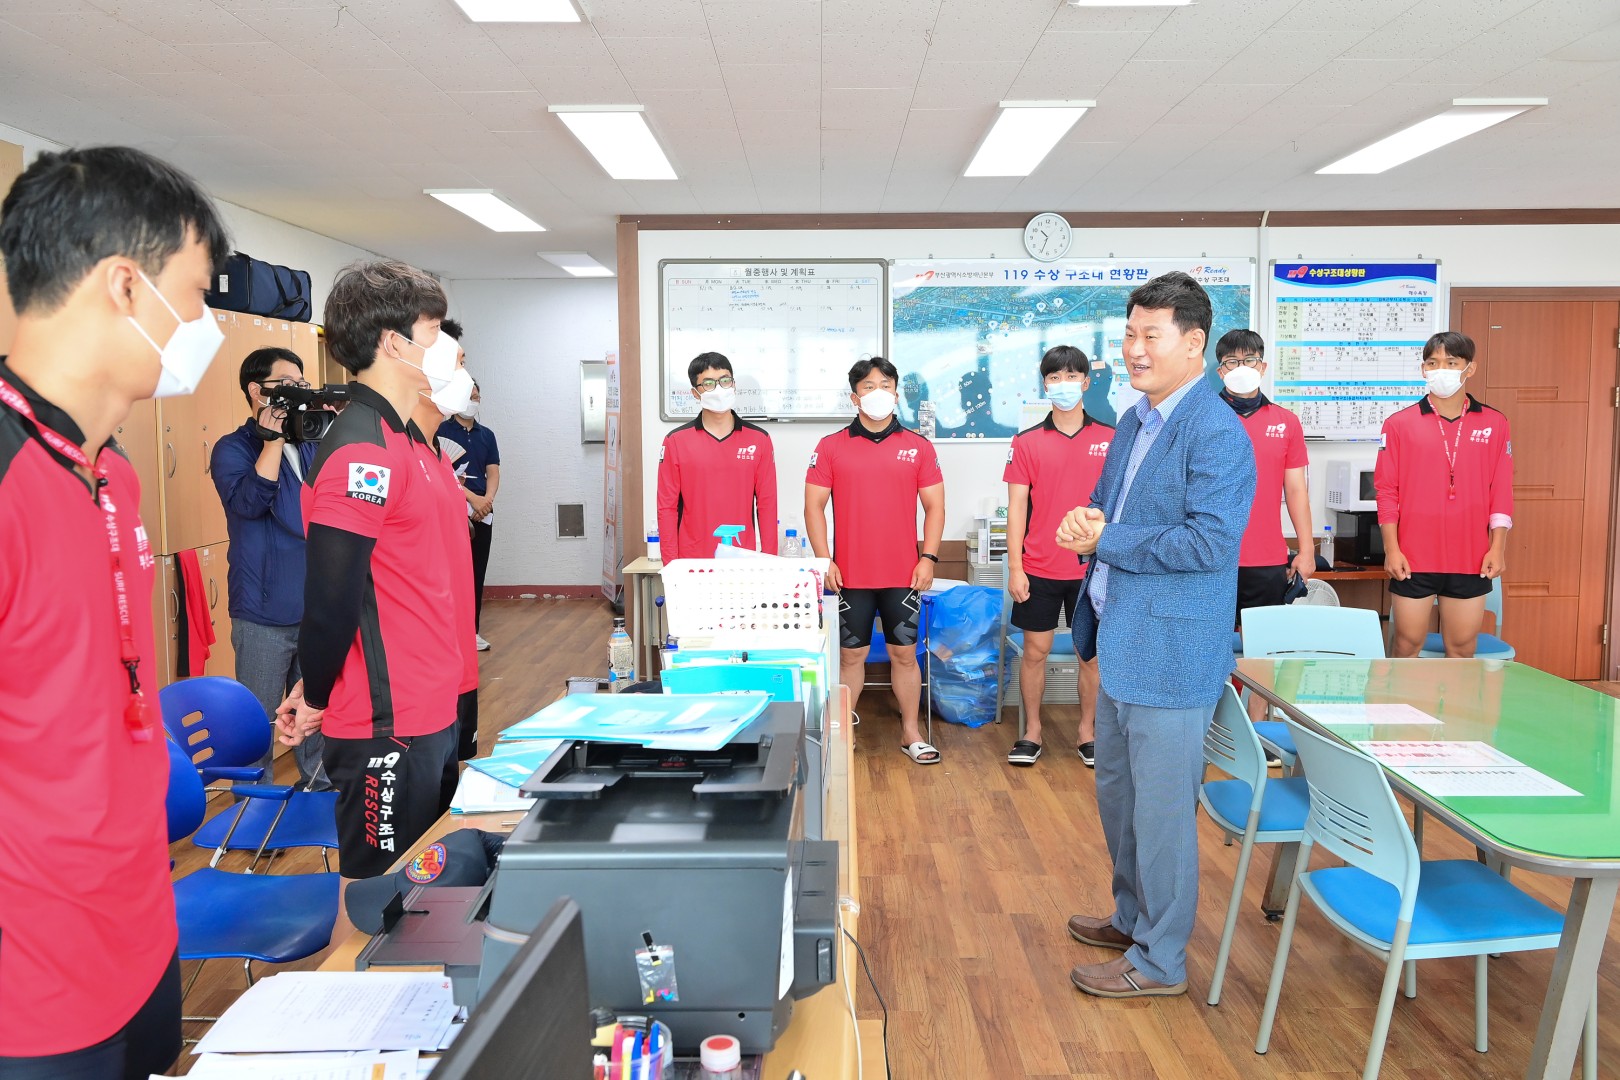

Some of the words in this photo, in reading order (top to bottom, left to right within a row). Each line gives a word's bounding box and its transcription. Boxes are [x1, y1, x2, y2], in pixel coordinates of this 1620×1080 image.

[745, 268, 777, 276] 월중행사
[780, 268, 788, 276] 및
[790, 268, 815, 276] 계획표
[1004, 269, 1028, 280] 119
[1034, 269, 1060, 280] 수상
[1310, 268, 1365, 277] 수상구조대상황판
[1266, 423, 1286, 433] 119
[1471, 428, 1492, 438] 119
[737, 445, 756, 455] 119
[1089, 442, 1109, 451] 119
[898, 448, 918, 457] 119
[352, 492, 382, 504] KOREA
[106, 514, 120, 552] 수상구조대
[114, 571, 124, 593] SURF
[117, 594, 130, 626] RESCUE
[367, 752, 400, 768] 119
[365, 774, 379, 848] RESCUE
[378, 770, 396, 852] 수상구조대
